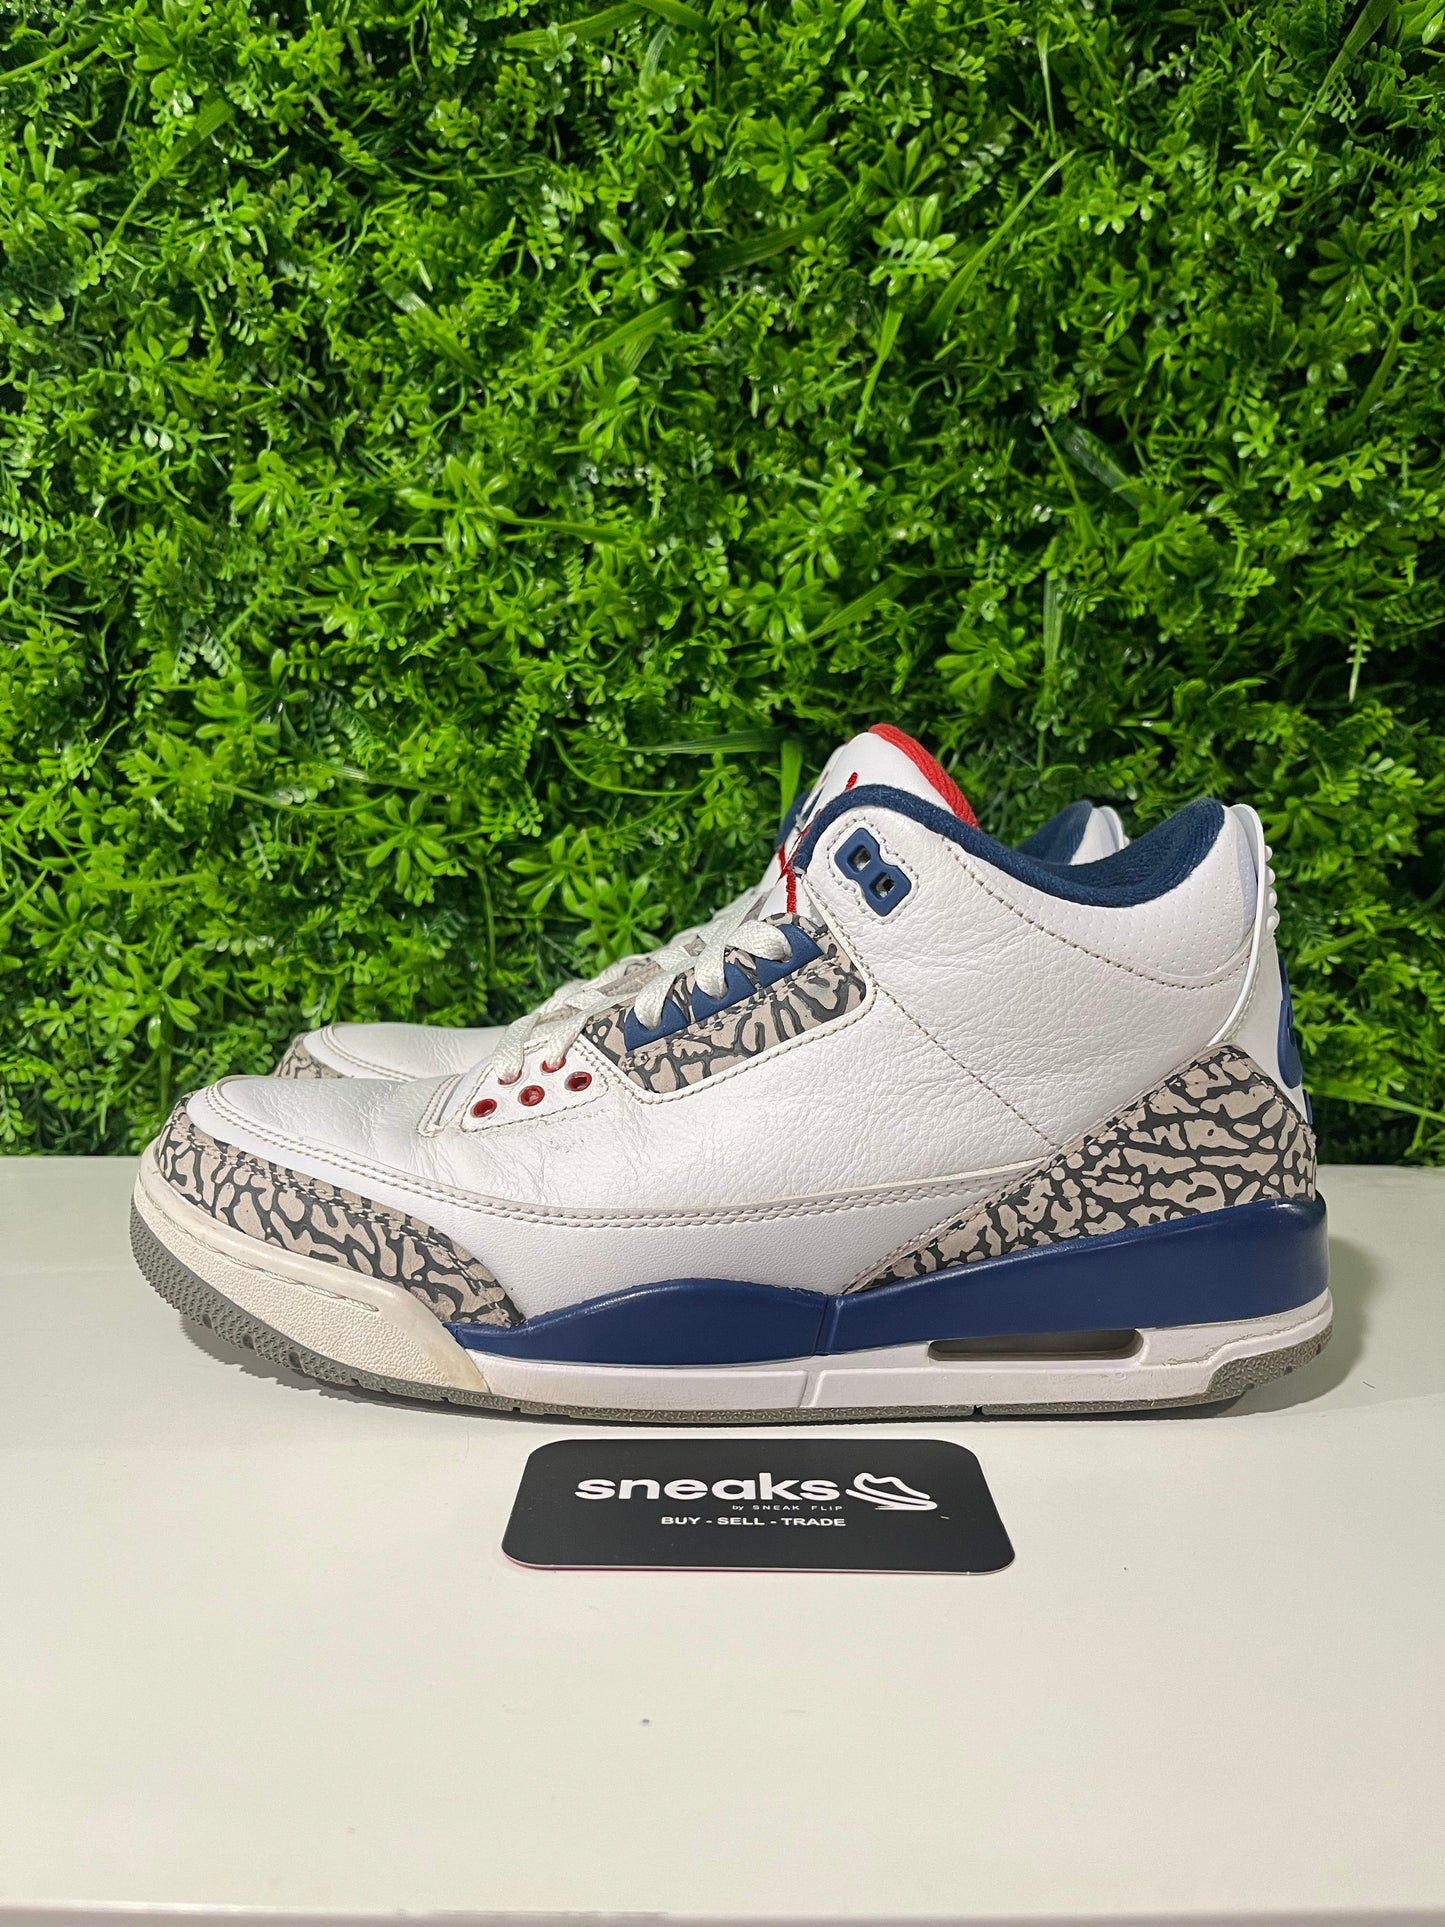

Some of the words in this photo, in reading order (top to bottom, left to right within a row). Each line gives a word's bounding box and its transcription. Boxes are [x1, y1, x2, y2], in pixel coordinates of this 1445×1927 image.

[574, 1472, 841, 1501] sneaks
[732, 1504, 744, 1512] by
[660, 1516, 701, 1525] BUY
[716, 1516, 766, 1526] SELL
[780, 1517, 847, 1527] TRADE
